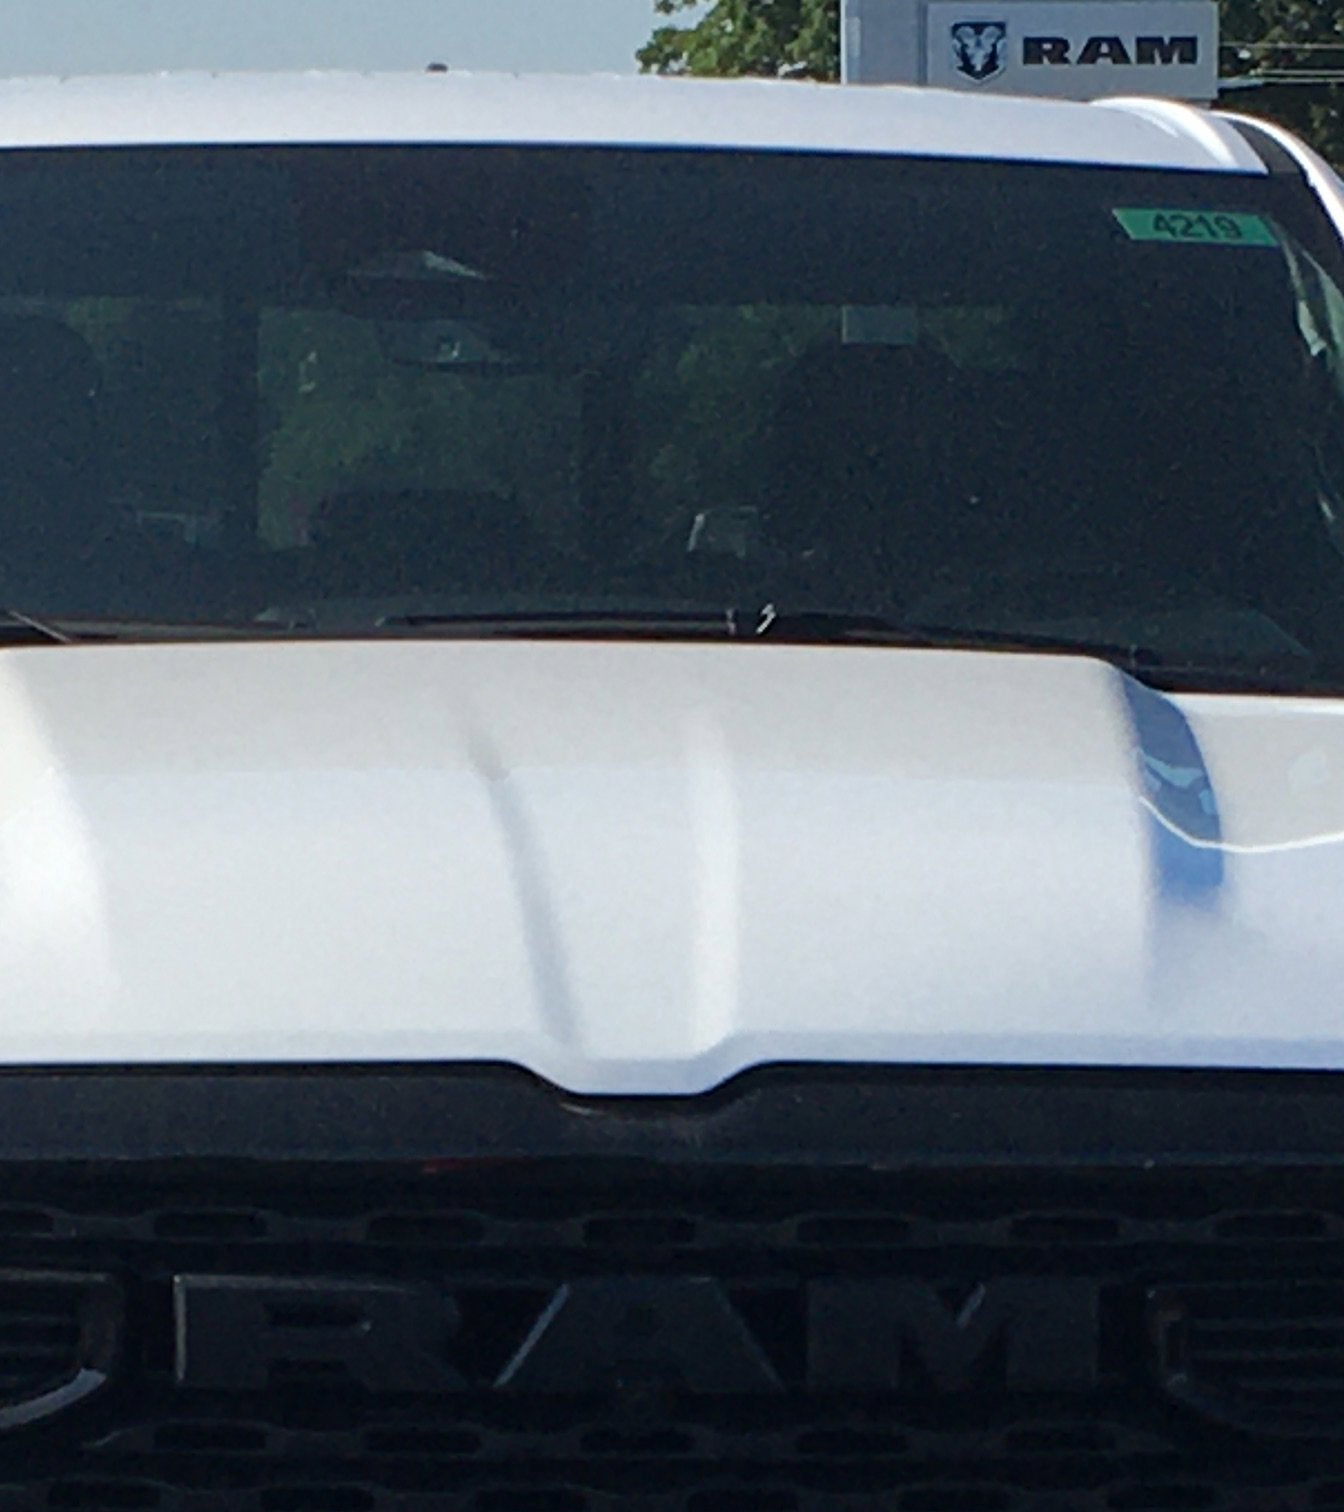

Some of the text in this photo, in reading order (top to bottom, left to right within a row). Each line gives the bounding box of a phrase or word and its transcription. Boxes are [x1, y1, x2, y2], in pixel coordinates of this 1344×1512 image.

[1022, 36, 1199, 65] RAM
[1153, 214, 1243, 238] 4219
[172, 1275, 1102, 1392] RAM
